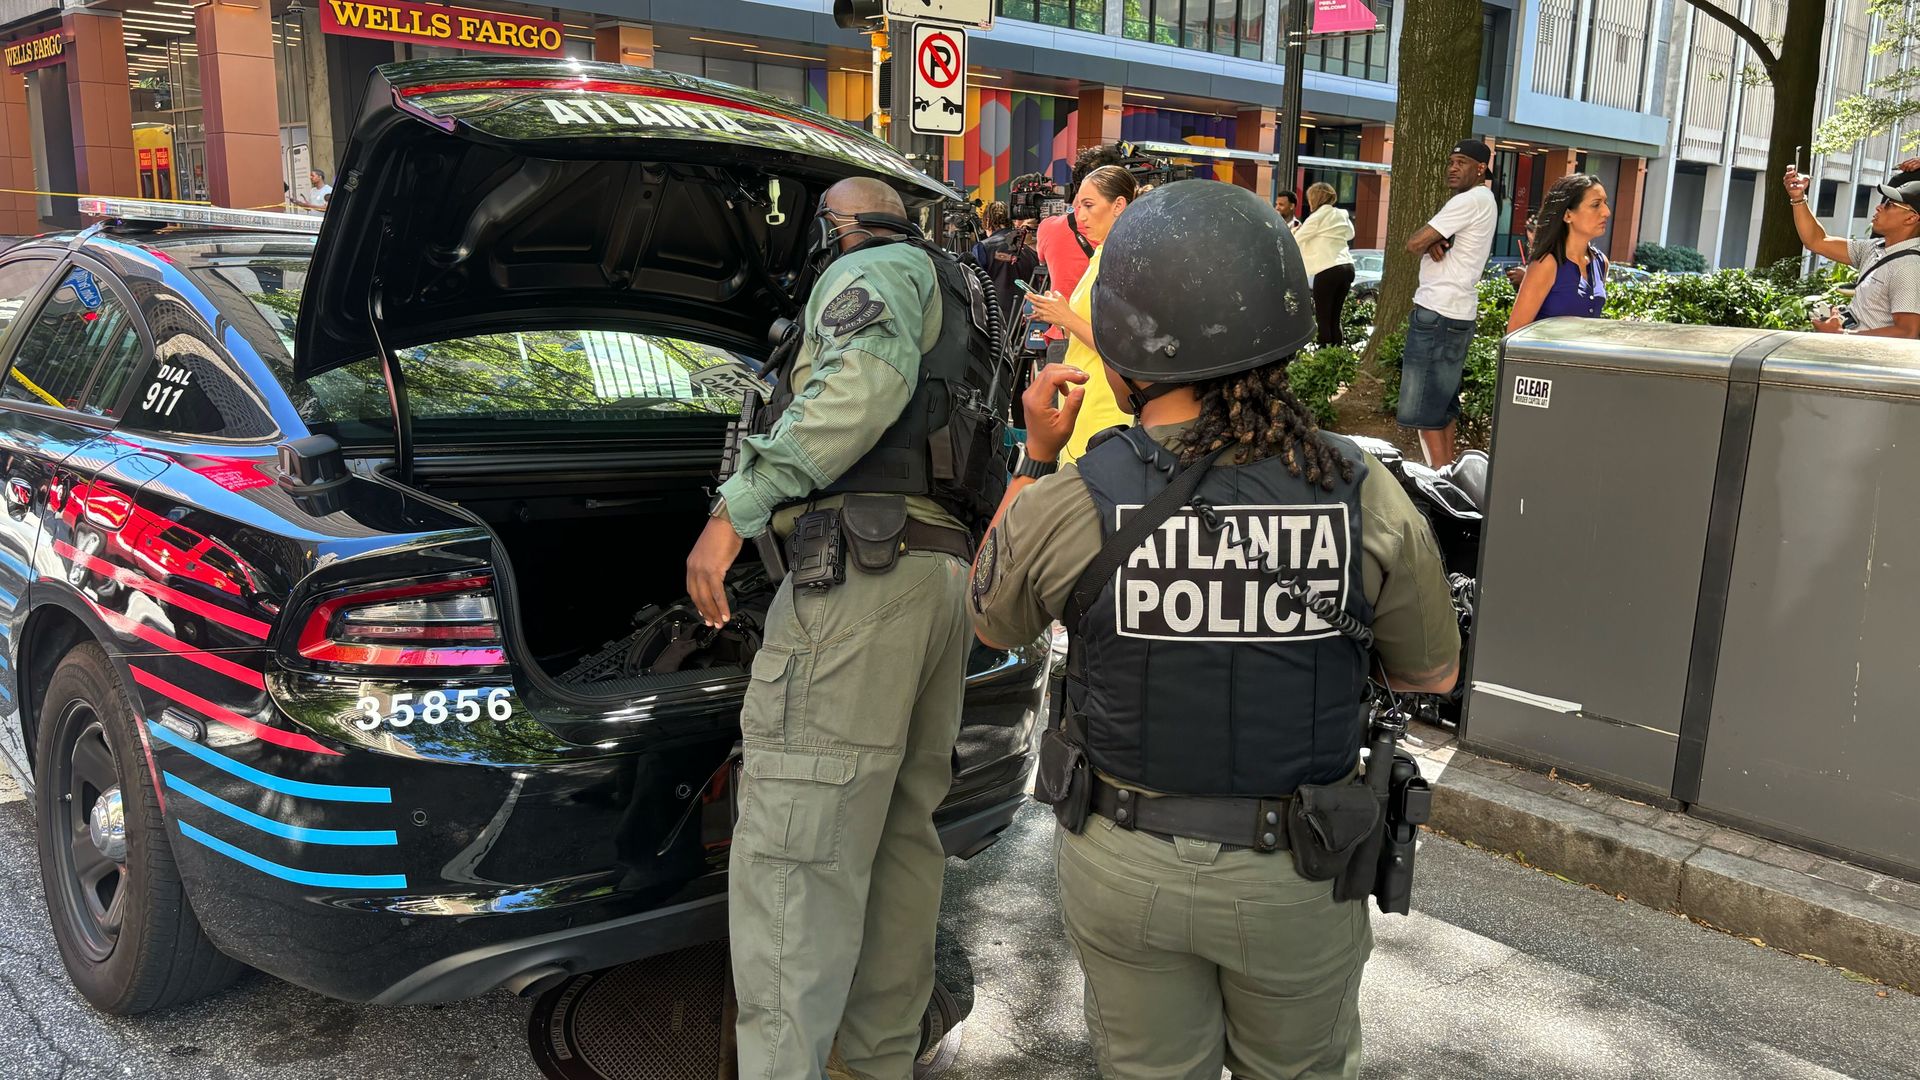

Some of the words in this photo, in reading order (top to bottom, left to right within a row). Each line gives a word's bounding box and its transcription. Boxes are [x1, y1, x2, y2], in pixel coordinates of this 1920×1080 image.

[329, 0, 451, 38] WELLS
[457, 16, 561, 50] FARGO
[5, 42, 33, 67] WELLS
[33, 33, 62, 60] FARGO
[541, 99, 752, 135] ATLANTA
[157, 364, 192, 386] DIAL
[1516, 378, 1549, 398] CLEAR
[142, 382, 184, 416] 911
[1127, 515, 1339, 569] ATLANTA
[1126, 579, 1339, 633] POLICE
[355, 688, 512, 731] 35856
